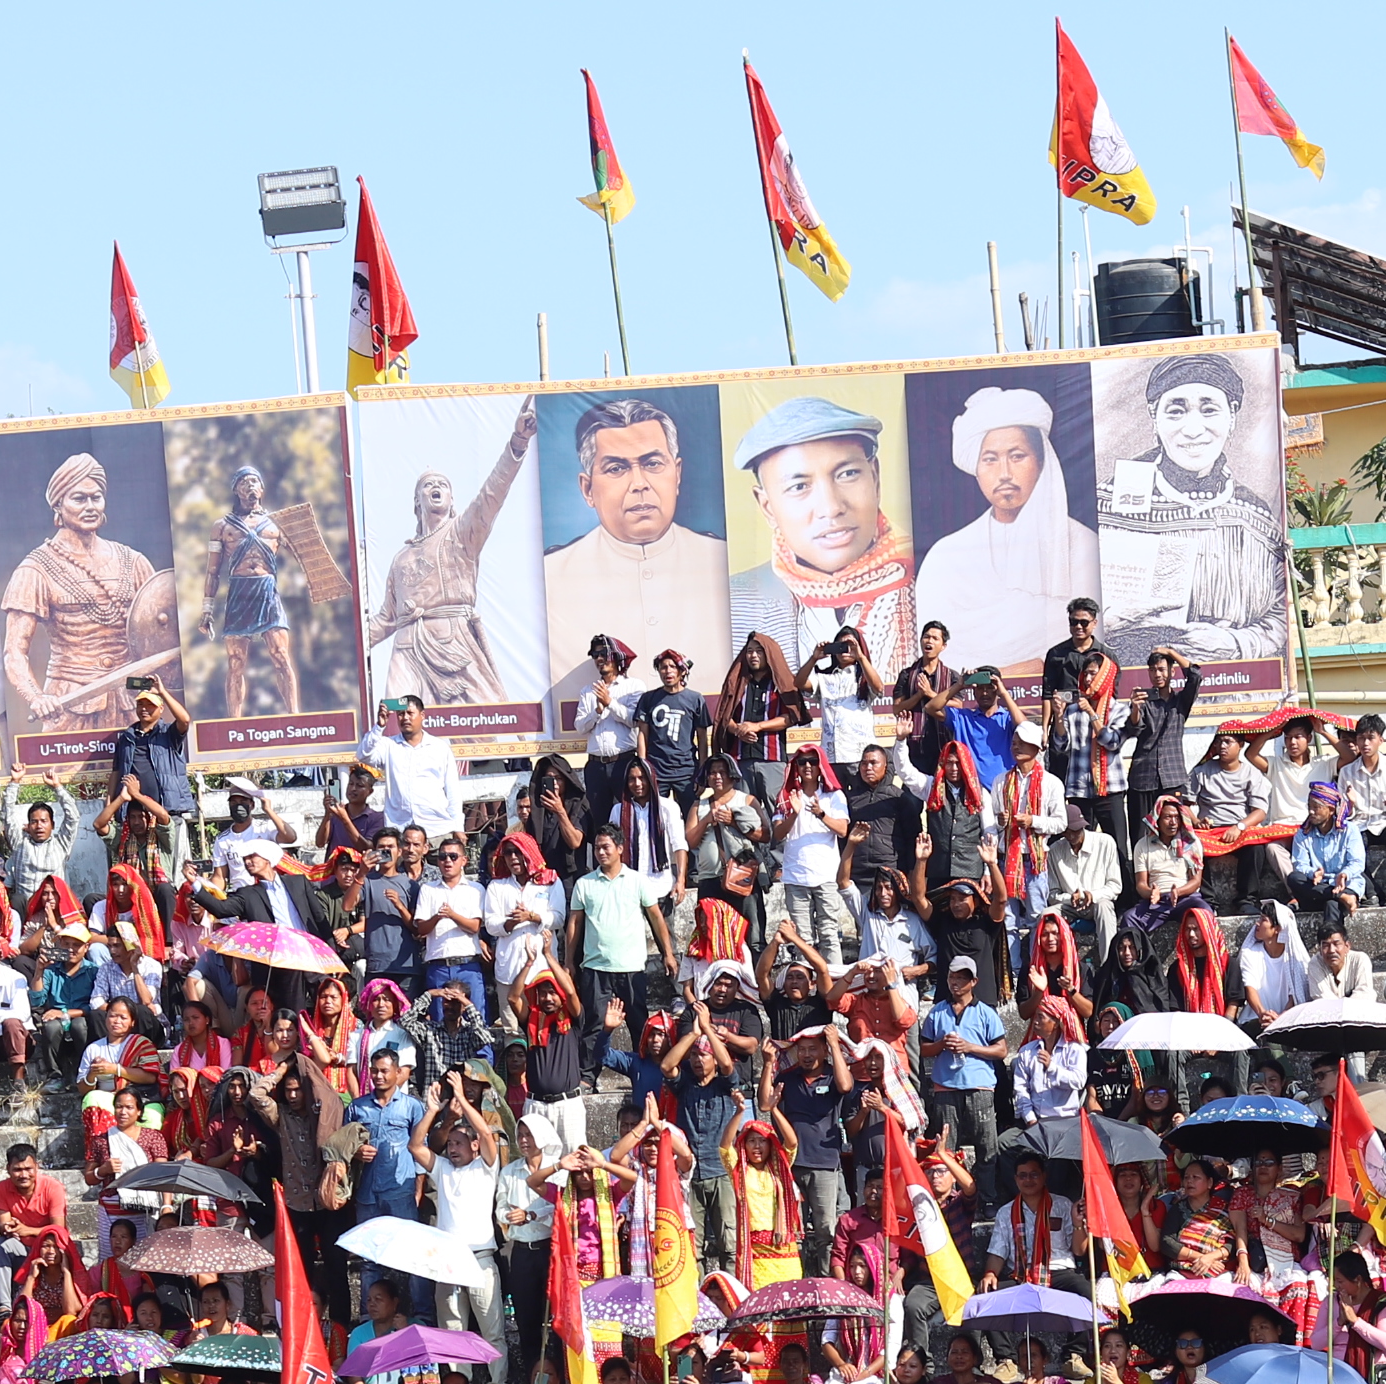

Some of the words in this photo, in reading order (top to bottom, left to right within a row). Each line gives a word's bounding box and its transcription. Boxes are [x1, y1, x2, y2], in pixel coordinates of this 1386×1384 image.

[1118, 493, 1145, 506] 25
[228, 730, 245, 743] Pa
[246, 727, 285, 743] Togan
[287, 724, 336, 741] Sangma
